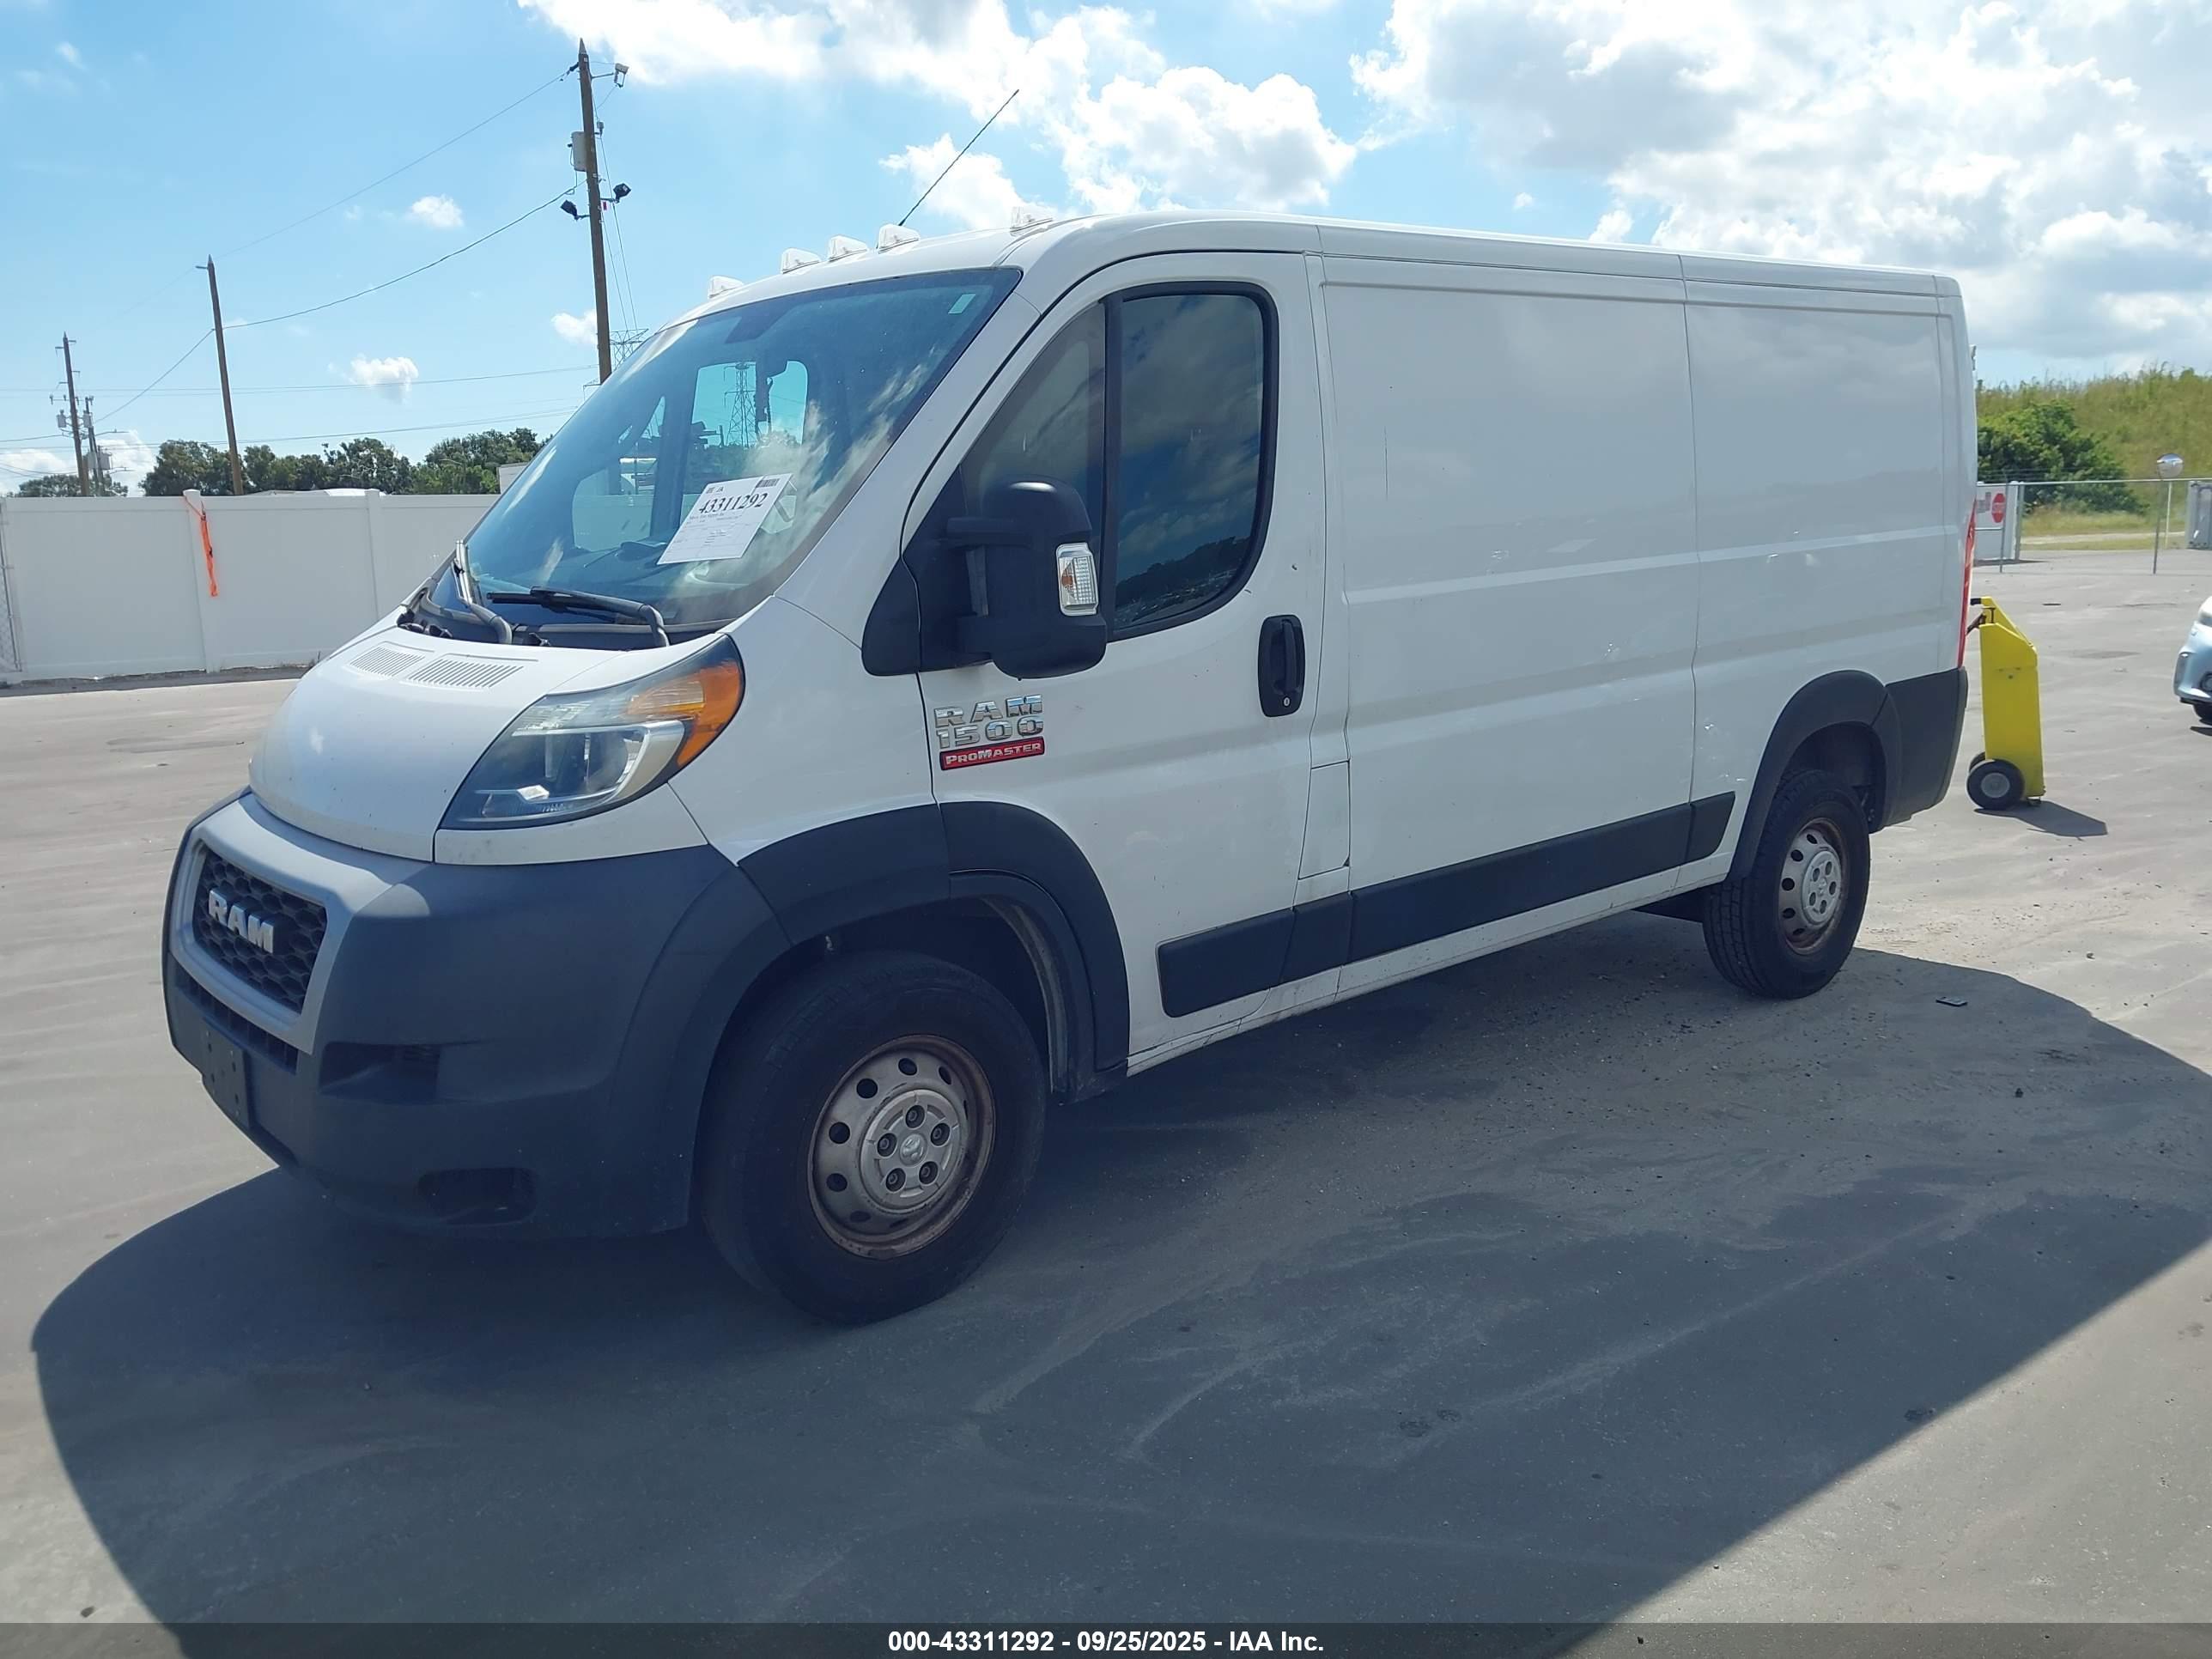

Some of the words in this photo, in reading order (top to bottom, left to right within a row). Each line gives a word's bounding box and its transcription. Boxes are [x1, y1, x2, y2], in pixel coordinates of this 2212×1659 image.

[699, 492, 768, 514] 43311292
[934, 695, 1042, 728] RAM
[936, 715, 1044, 749] 1500
[209, 890, 274, 954] RAM
